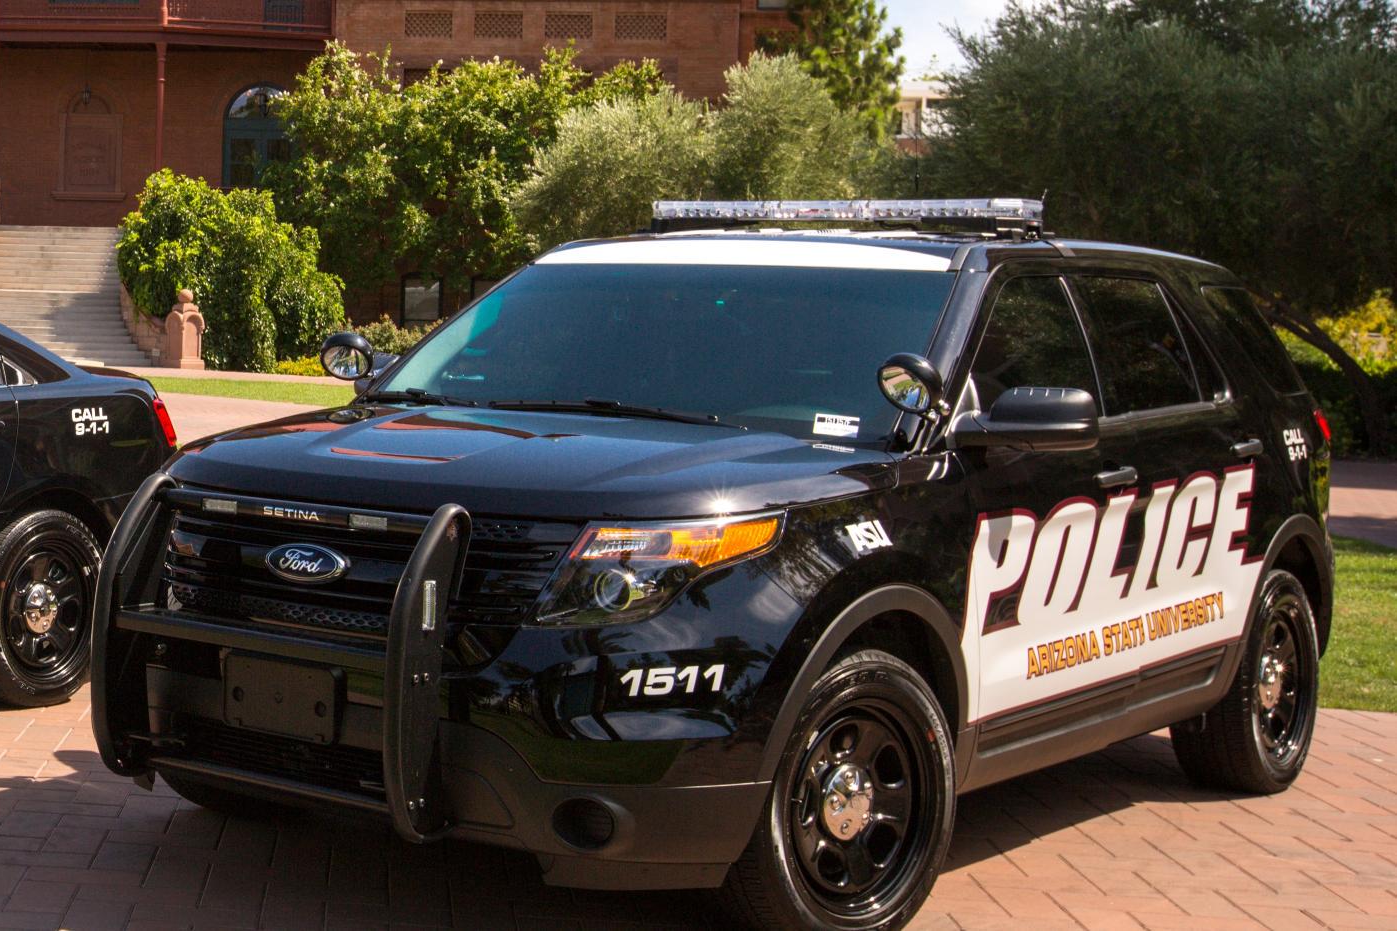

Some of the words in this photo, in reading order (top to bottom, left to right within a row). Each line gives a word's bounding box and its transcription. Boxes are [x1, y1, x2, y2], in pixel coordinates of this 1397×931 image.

[71, 406, 108, 422] CALL
[75, 420, 110, 436] 9-1-1
[1282, 428, 1304, 446] CALL
[1287, 444, 1308, 461] 9-1-1
[263, 506, 320, 521] SETINA
[844, 519, 893, 552] ASU
[279, 548, 323, 573] Ford
[965, 463, 1257, 637] POLICE
[1026, 630, 1101, 680] ARIZONA
[1145, 591, 1224, 641] UNIVERSITY
[620, 664, 725, 697] 1511
